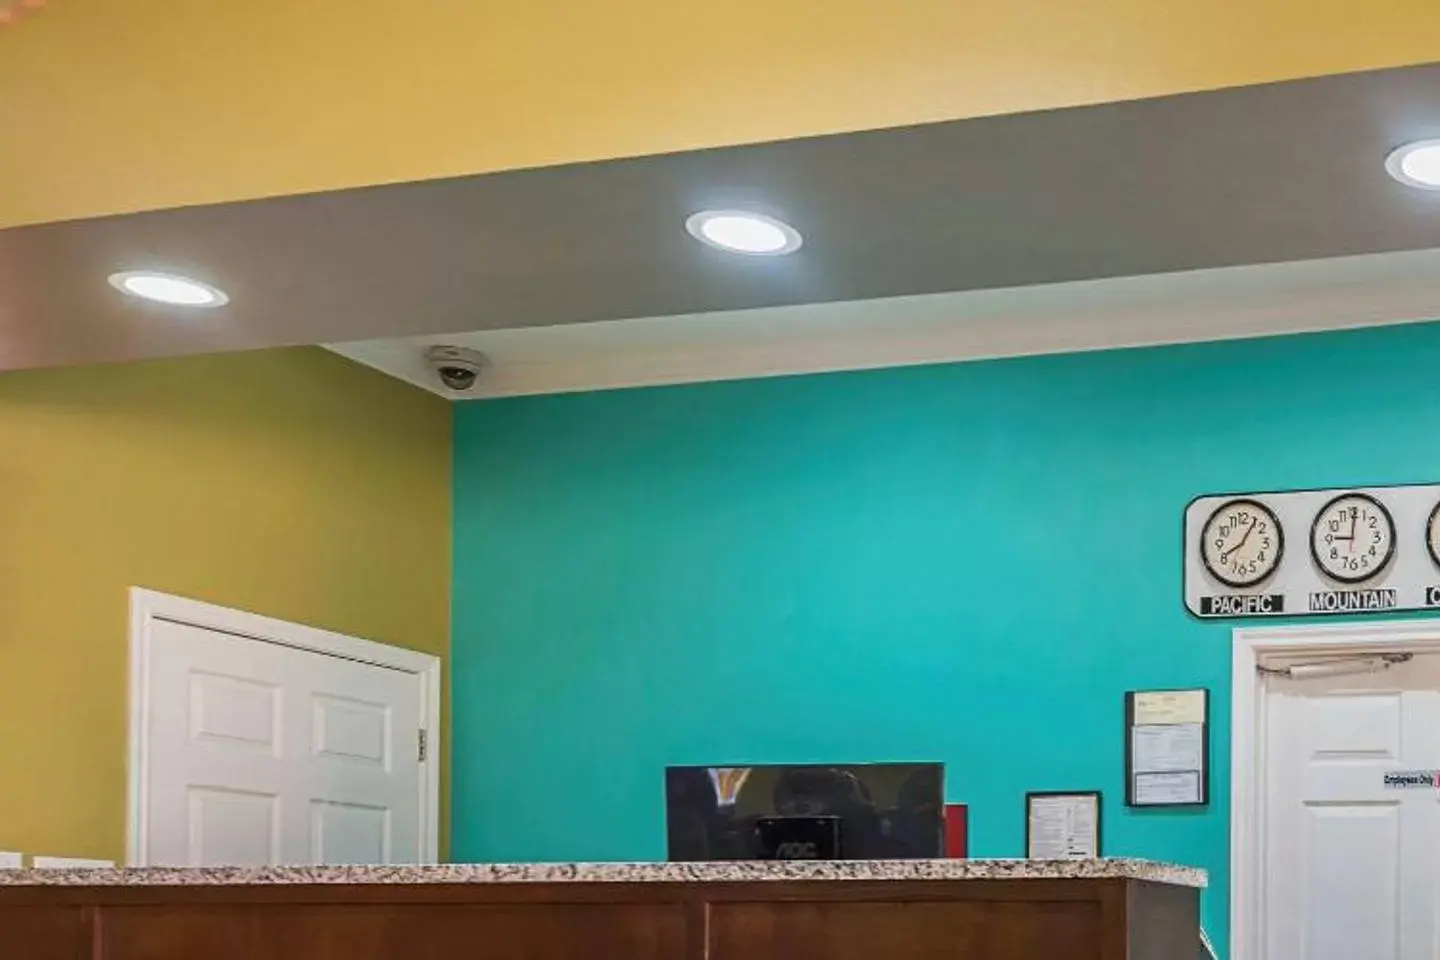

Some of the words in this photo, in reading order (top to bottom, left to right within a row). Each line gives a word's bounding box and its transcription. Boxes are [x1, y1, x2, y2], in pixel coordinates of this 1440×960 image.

[1229, 515, 1238, 528] 11
[1237, 511, 1249, 525] 12
[1338, 510, 1347, 522] 11
[1361, 509, 1366, 522] 1
[1258, 522, 1267, 534] 2
[1328, 520, 1339, 532] 10
[1368, 516, 1378, 529] 2
[1219, 525, 1230, 538] 10
[1373, 531, 1381, 544] 3
[1215, 539, 1224, 551] 9
[1261, 537, 1270, 550] 3
[1324, 533, 1334, 546] 9
[1257, 551, 1266, 563] 4
[1330, 547, 1338, 560] 8
[1368, 545, 1376, 556] 4
[1220, 552, 1227, 565] 8
[1340, 556, 1349, 569] 7
[1349, 558, 1359, 571] 6
[1360, 555, 1368, 567] 5
[1230, 561, 1238, 574] 7
[1238, 564, 1247, 575] 6
[1248, 560, 1257, 573] 5
[1211, 595, 1273, 614] PACIFIC
[1310, 589, 1396, 610] MOUNTAIN
[1419, 773, 1433, 787] Only
